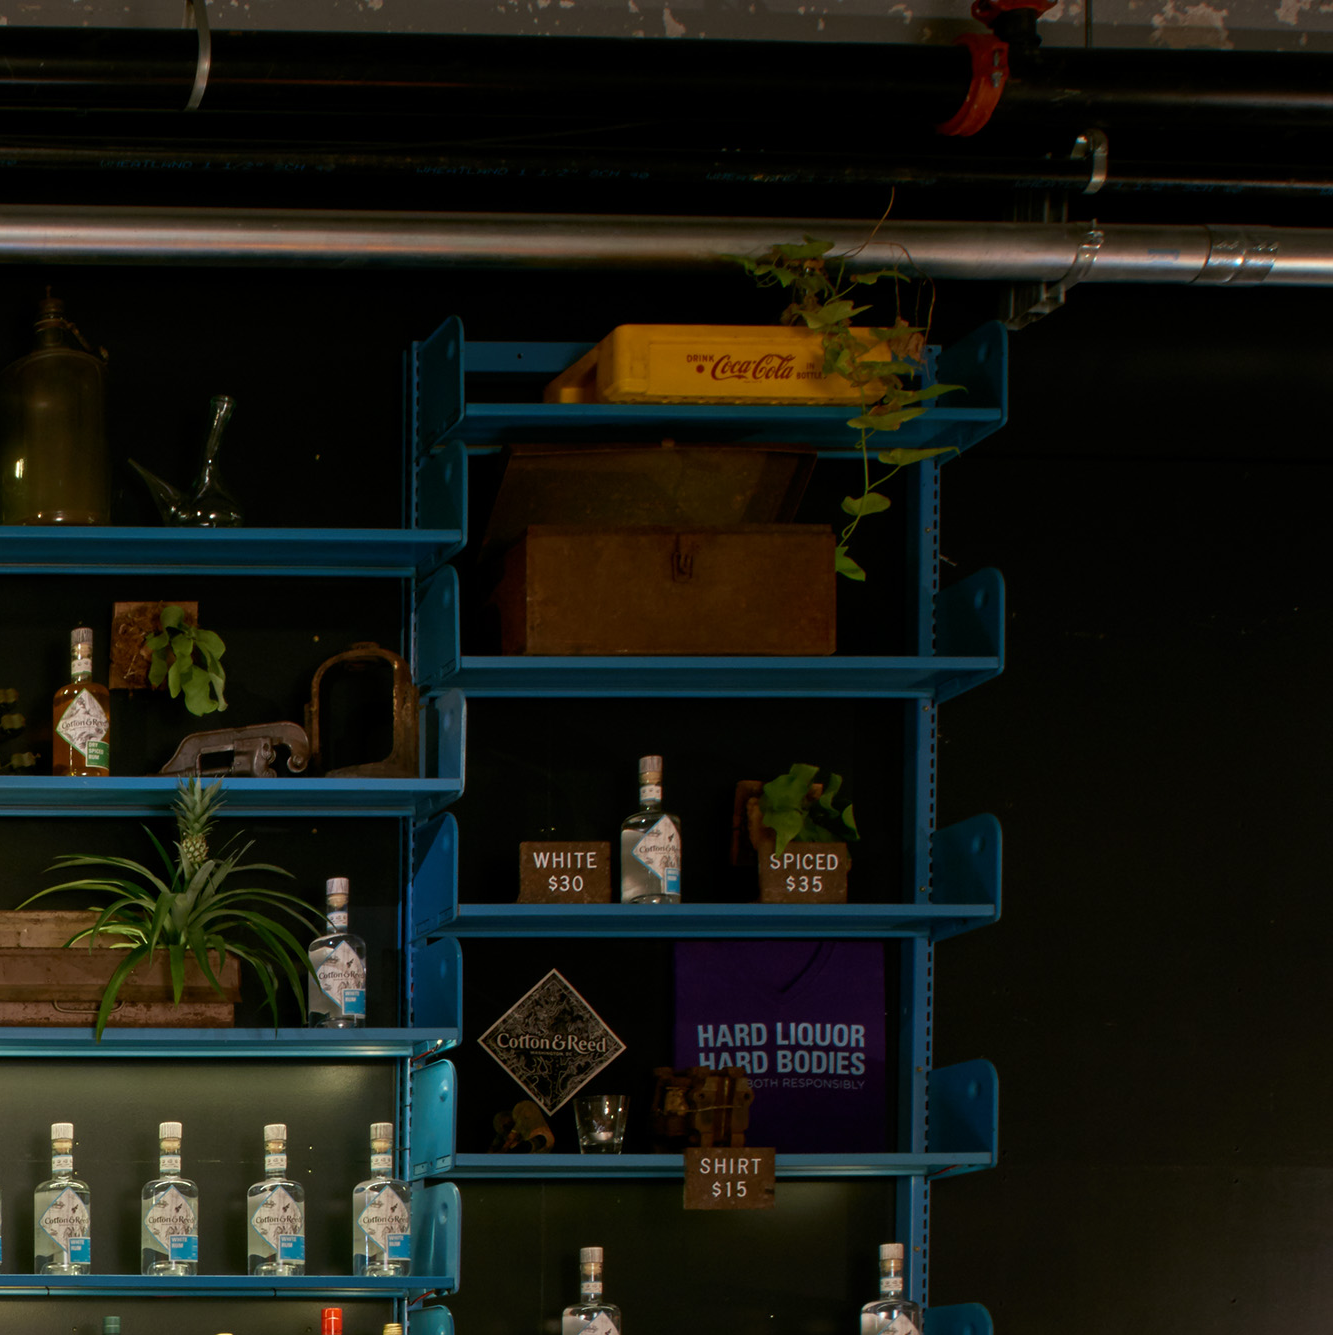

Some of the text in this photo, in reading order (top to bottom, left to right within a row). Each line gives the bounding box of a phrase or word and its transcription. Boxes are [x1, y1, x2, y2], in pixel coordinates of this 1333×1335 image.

[687, 354, 796, 380] DRINK Coca-Cola
[533, 852, 597, 870] WHITE
[770, 853, 839, 872] SPICED
[548, 874, 584, 893] $30
[786, 875, 823, 893] $35
[697, 1022, 865, 1047] HARD LIQUOR
[699, 1050, 865, 1075] HARD BODIES
[747, 1078, 865, 1089] BOTH RESPONSIBLY
[700, 1158, 762, 1175] SHIRT
[712, 1181, 748, 1200] $15
